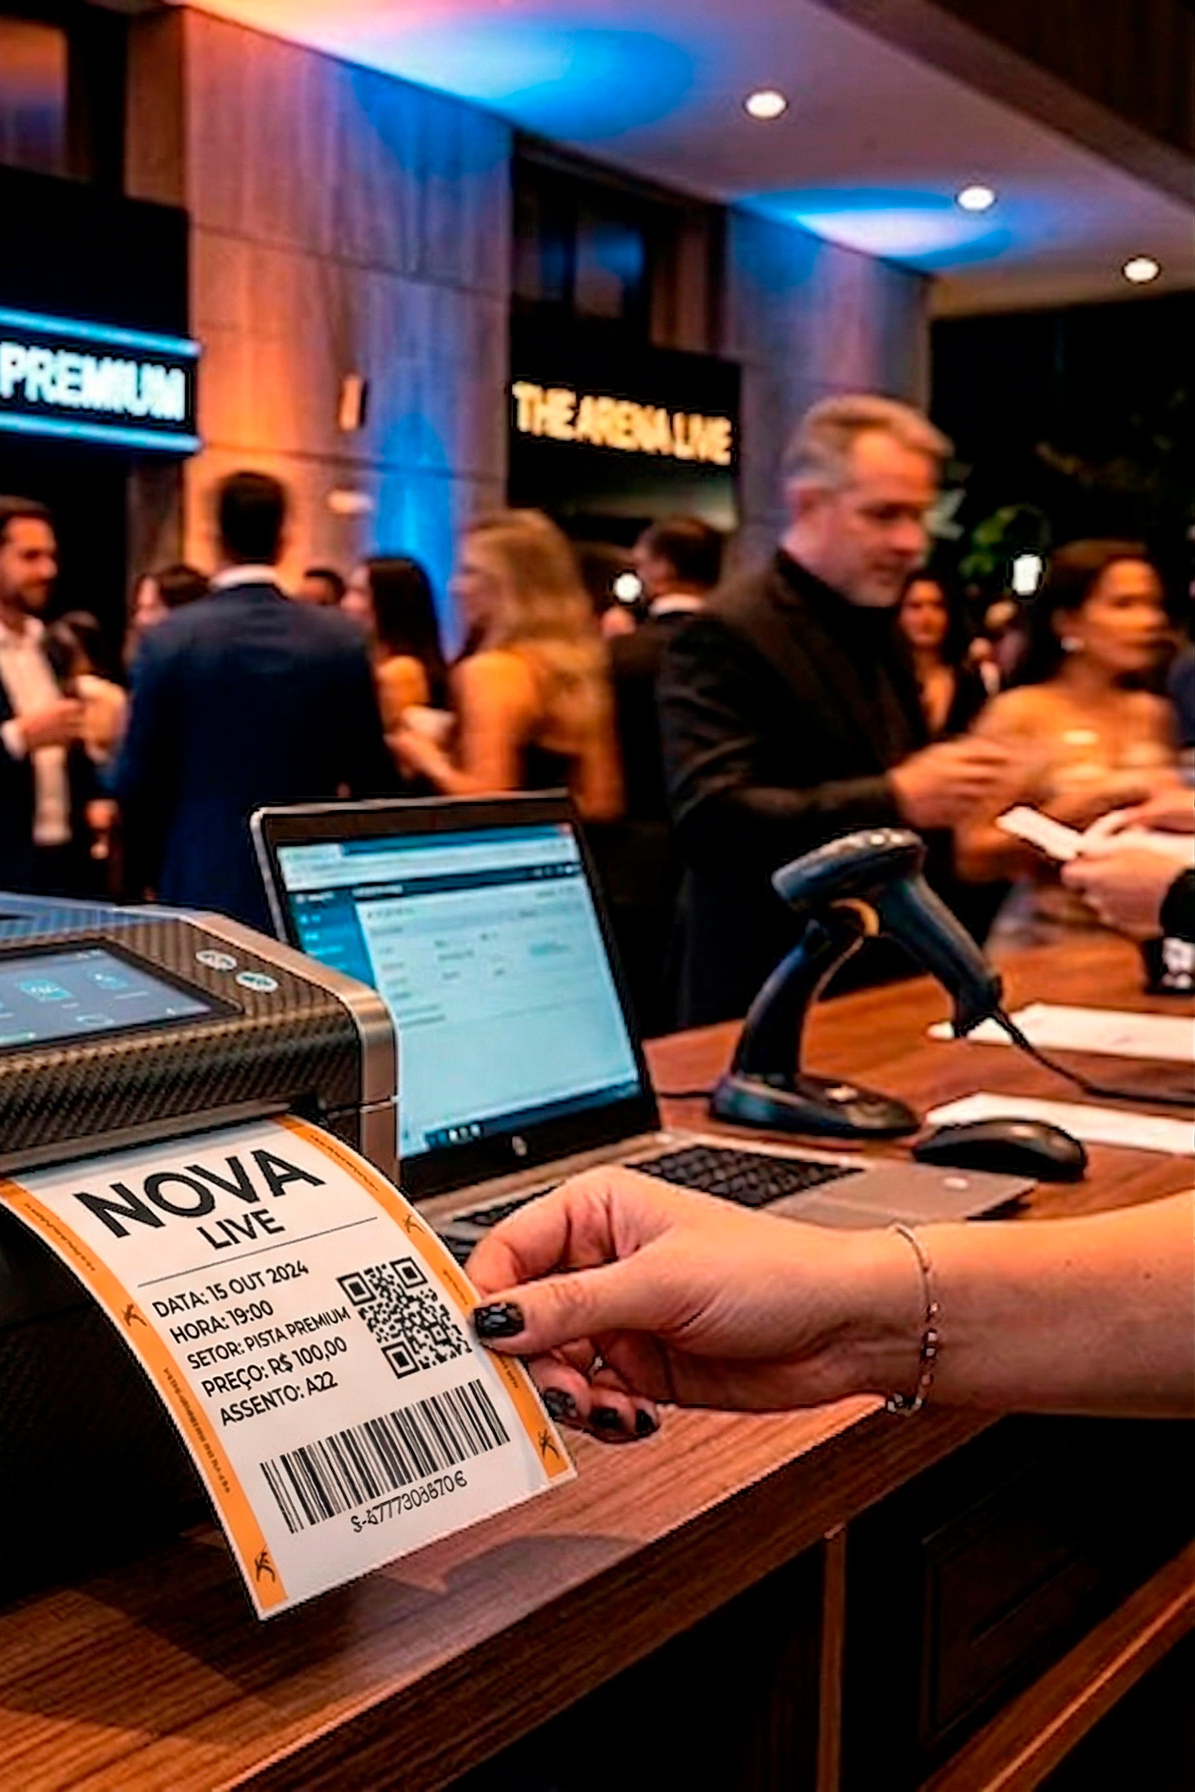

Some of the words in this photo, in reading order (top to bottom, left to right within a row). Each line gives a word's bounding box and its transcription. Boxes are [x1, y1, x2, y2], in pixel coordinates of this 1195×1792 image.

[511, 381, 578, 441] THE
[577, 395, 673, 456] ARENA
[672, 412, 733, 467] LIVE
[72, 1149, 326, 1239] NOVA
[196, 1208, 286, 1251] LIVE
[152, 1291, 209, 1318] DATA:
[206, 1283, 229, 1301] 15
[228, 1271, 266, 1295] OUT
[265, 1260, 310, 1285] 2024
[169, 1315, 230, 1345] HORA:
[225, 1299, 275, 1327] 19:00
[187, 1340, 246, 1370] SETOR:
[243, 1327, 289, 1352] PISTA
[285, 1306, 353, 1338] PREMIUM
[201, 1363, 269, 1398] PREÇO:
[266, 1351, 294, 1377] R$
[291, 1336, 348, 1367] 100,00
[220, 1384, 306, 1427] ASSENTO:
[304, 1370, 339, 1396] A22
